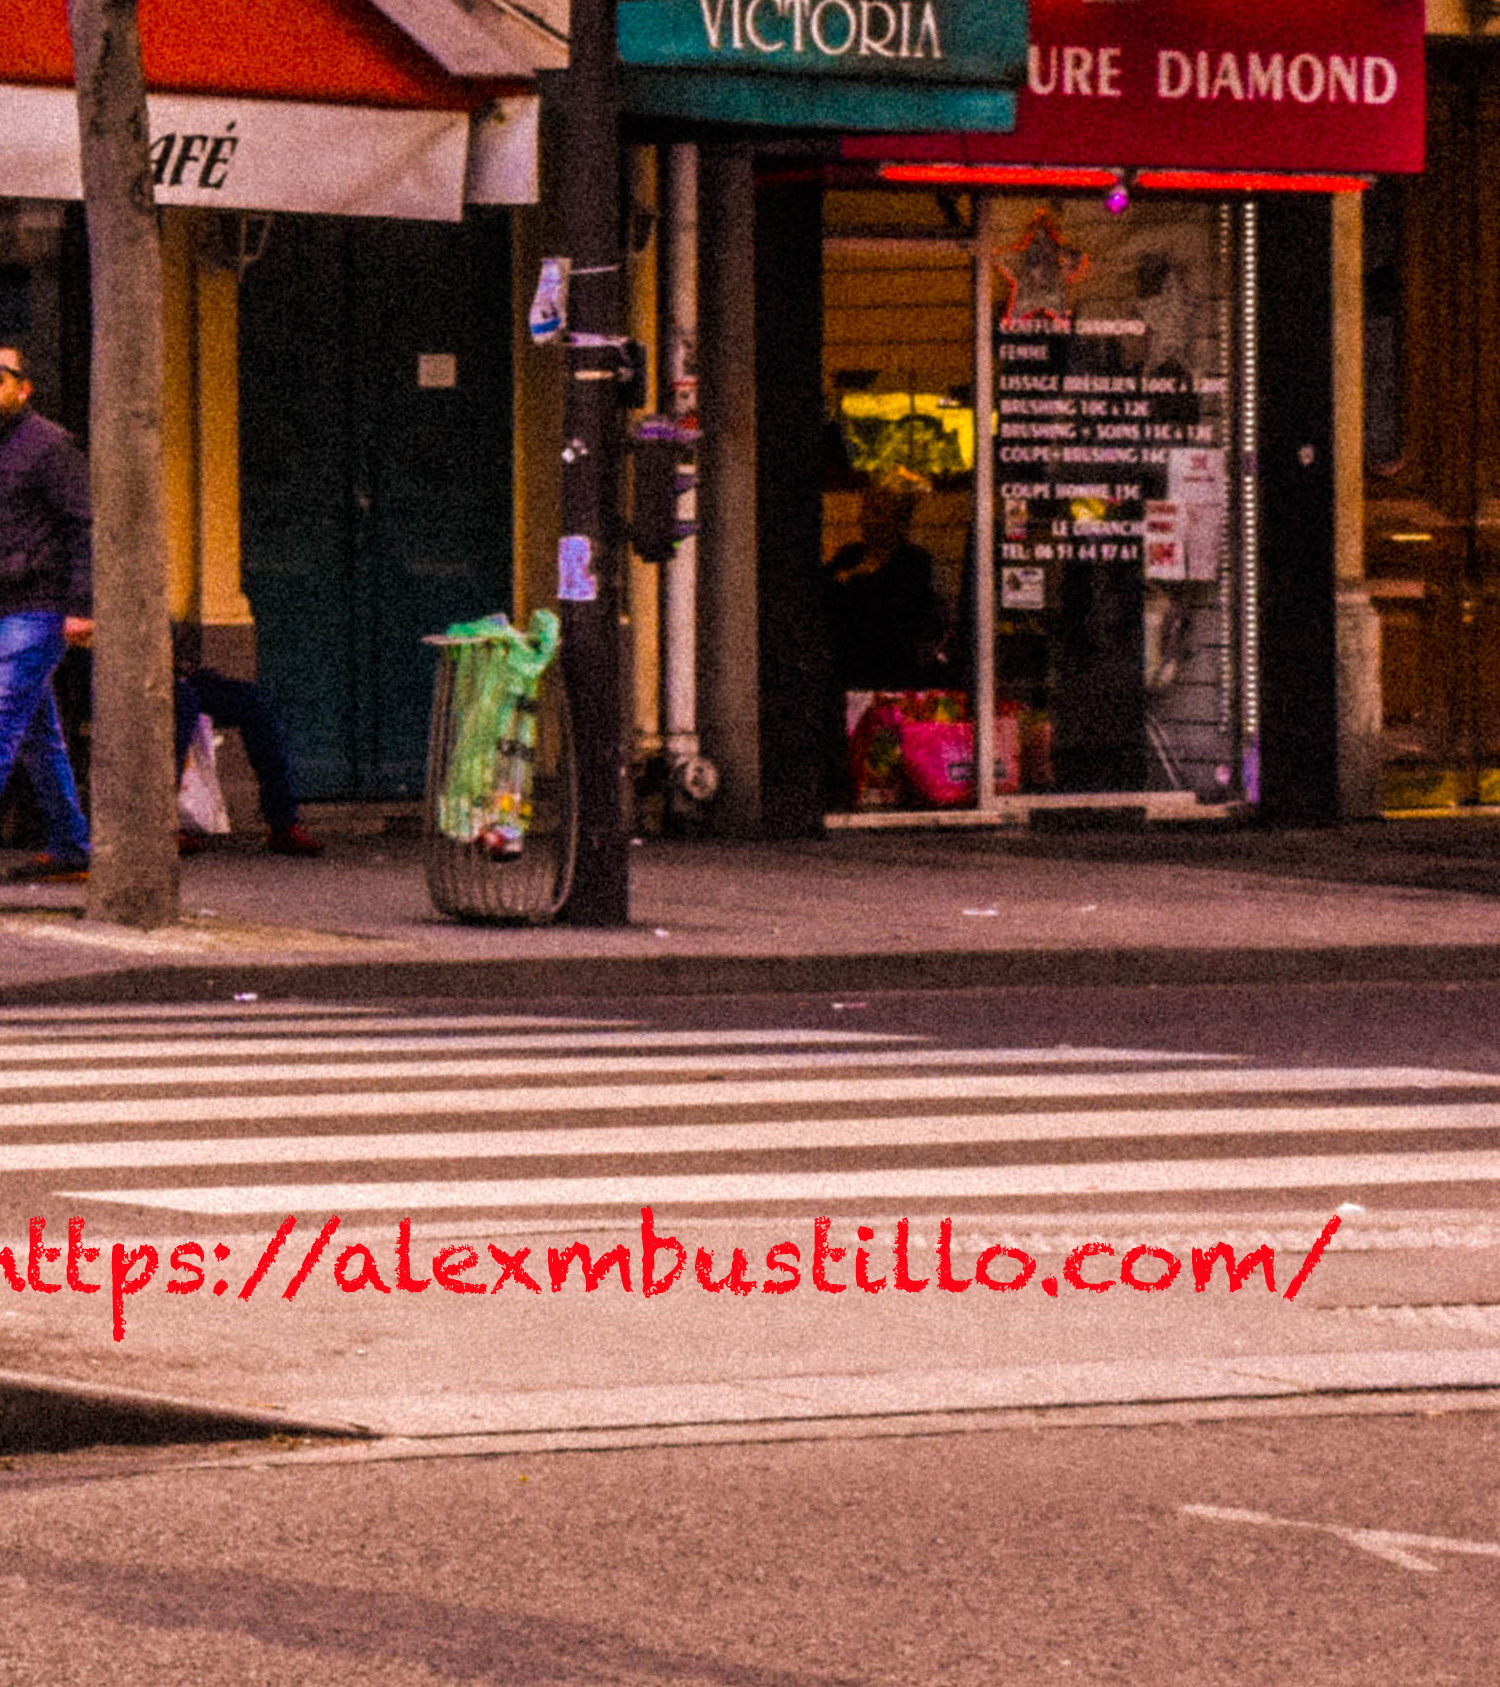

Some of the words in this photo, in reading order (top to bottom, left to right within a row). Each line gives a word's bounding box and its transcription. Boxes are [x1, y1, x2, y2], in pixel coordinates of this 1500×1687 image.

[1028, 45, 1121, 97] URE
[1157, 50, 1398, 104] DIAMOND
[150, 121, 238, 188] AFÉ
